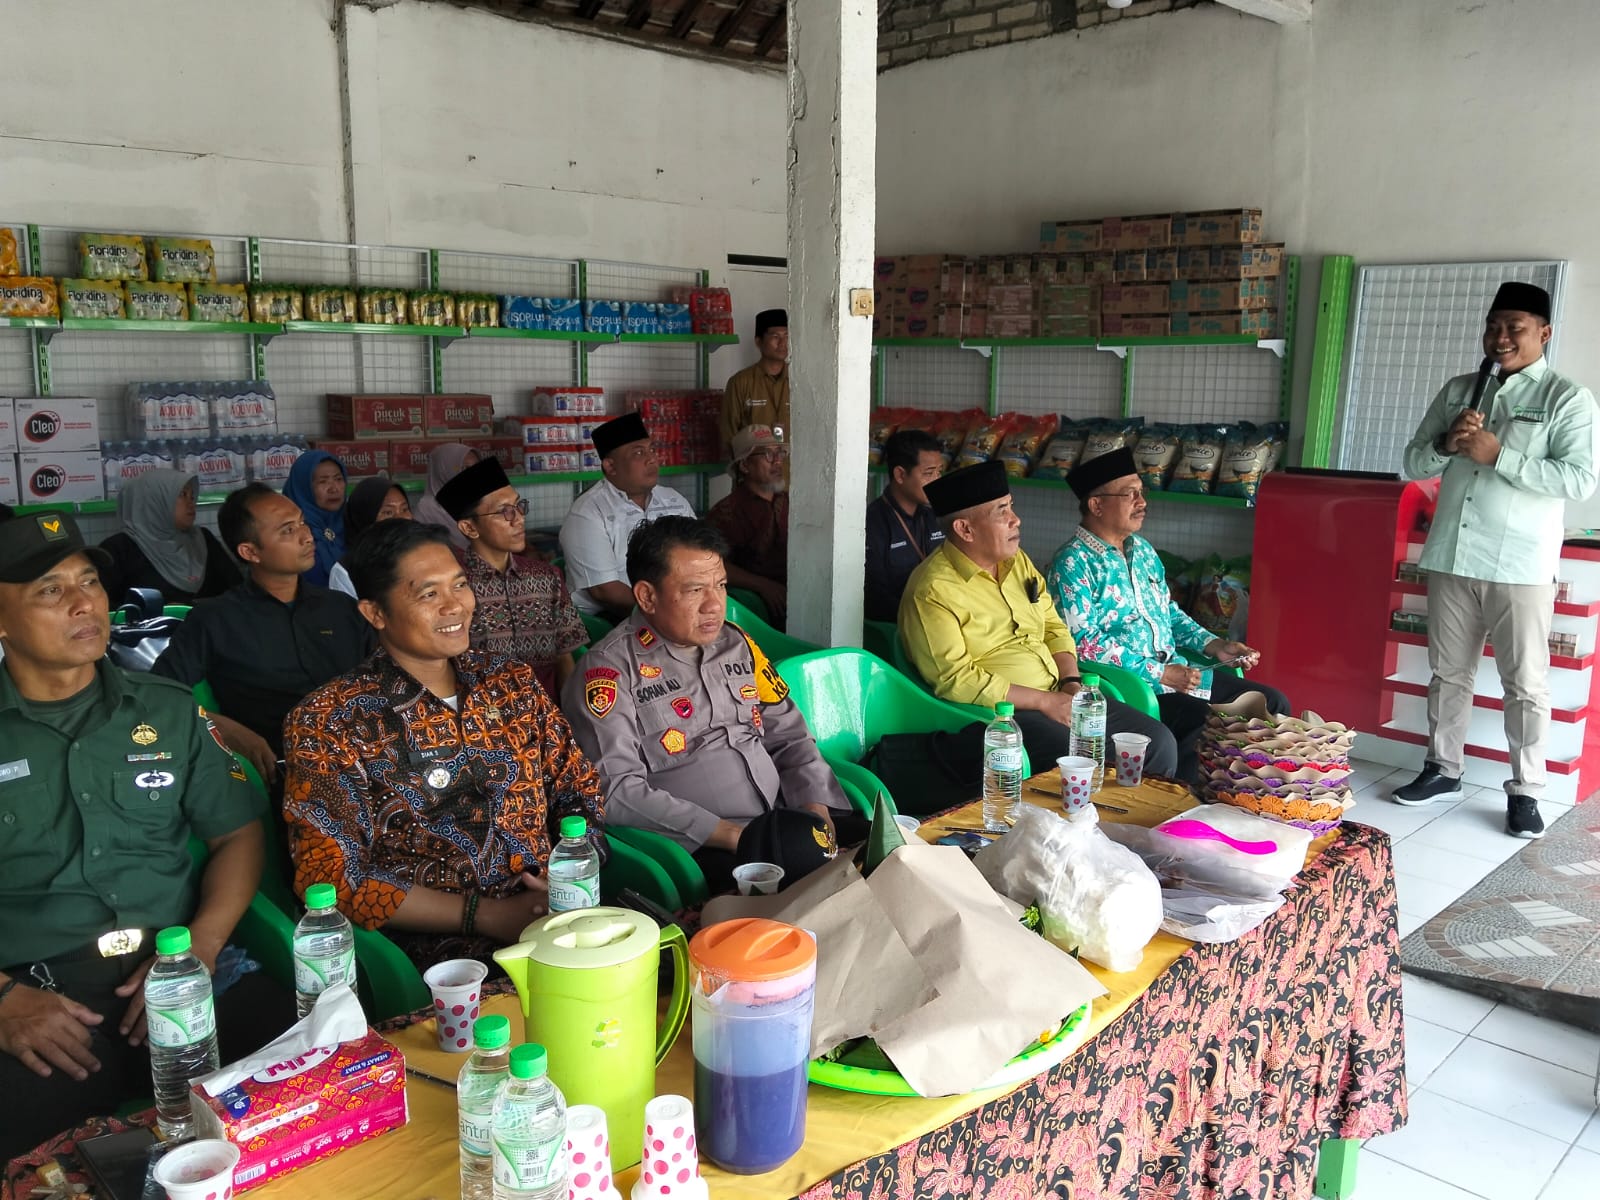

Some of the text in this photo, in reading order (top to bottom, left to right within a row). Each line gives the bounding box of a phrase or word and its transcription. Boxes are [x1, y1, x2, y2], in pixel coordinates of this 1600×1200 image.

[88, 244, 127, 256] Floridina
[162, 249, 198, 260] Floridina
[68, 290, 106, 301] Floridina
[132, 292, 169, 303] Floridina
[31, 420, 54, 434] Cleo
[36, 474, 60, 488] Cleo
[459, 1120, 490, 1140] antri
